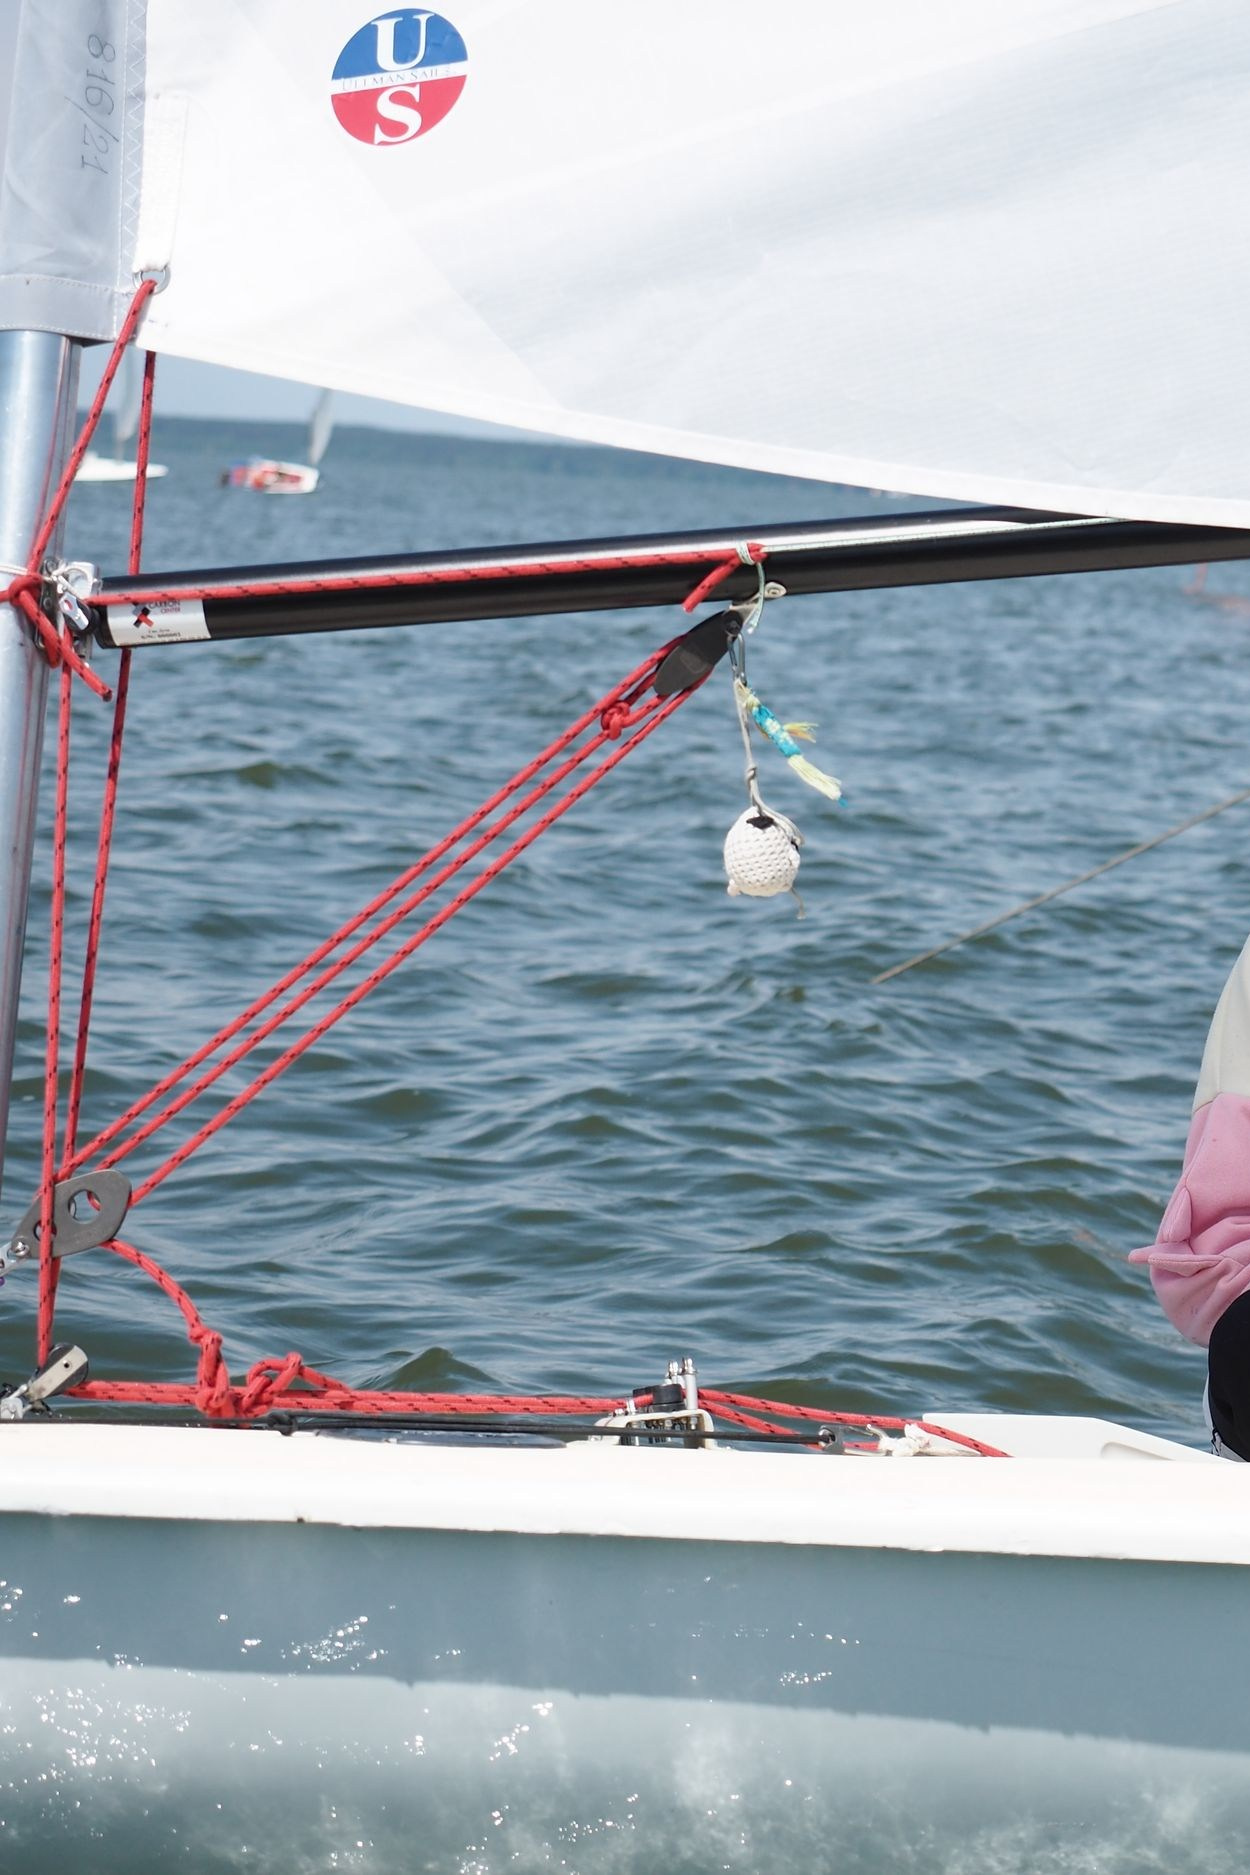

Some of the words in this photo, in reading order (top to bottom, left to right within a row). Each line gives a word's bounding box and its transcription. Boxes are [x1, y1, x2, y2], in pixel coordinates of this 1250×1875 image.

[370, 13, 435, 72] U
[64, 34, 119, 174] 816/21
[374, 83, 422, 145] S
